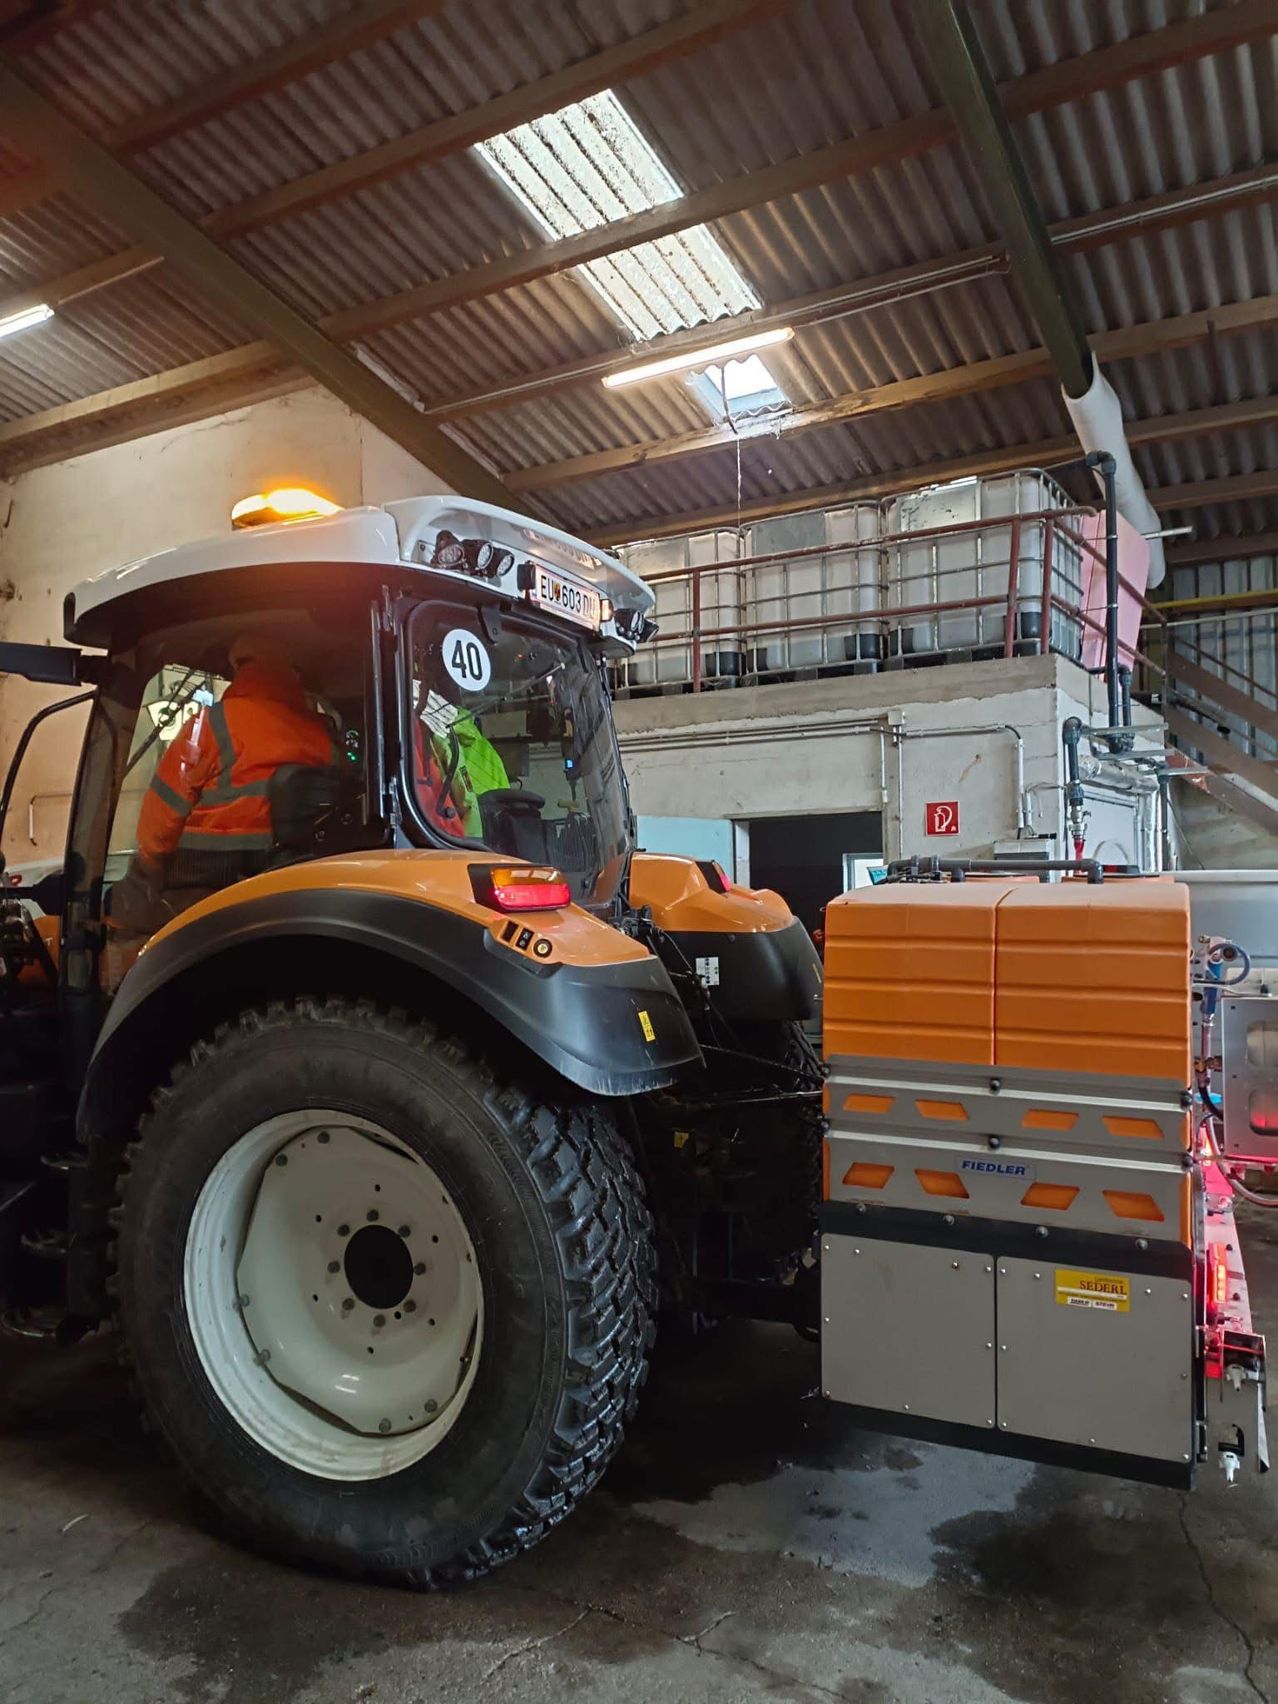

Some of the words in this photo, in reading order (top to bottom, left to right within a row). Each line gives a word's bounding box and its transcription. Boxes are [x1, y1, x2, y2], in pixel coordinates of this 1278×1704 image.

[541, 575, 554, 601] EU
[562, 585, 581, 613] 603
[451, 639, 483, 681] 40
[962, 1160, 1026, 1176] FIEDLER
[1079, 1280, 1128, 1295] SEDERL
